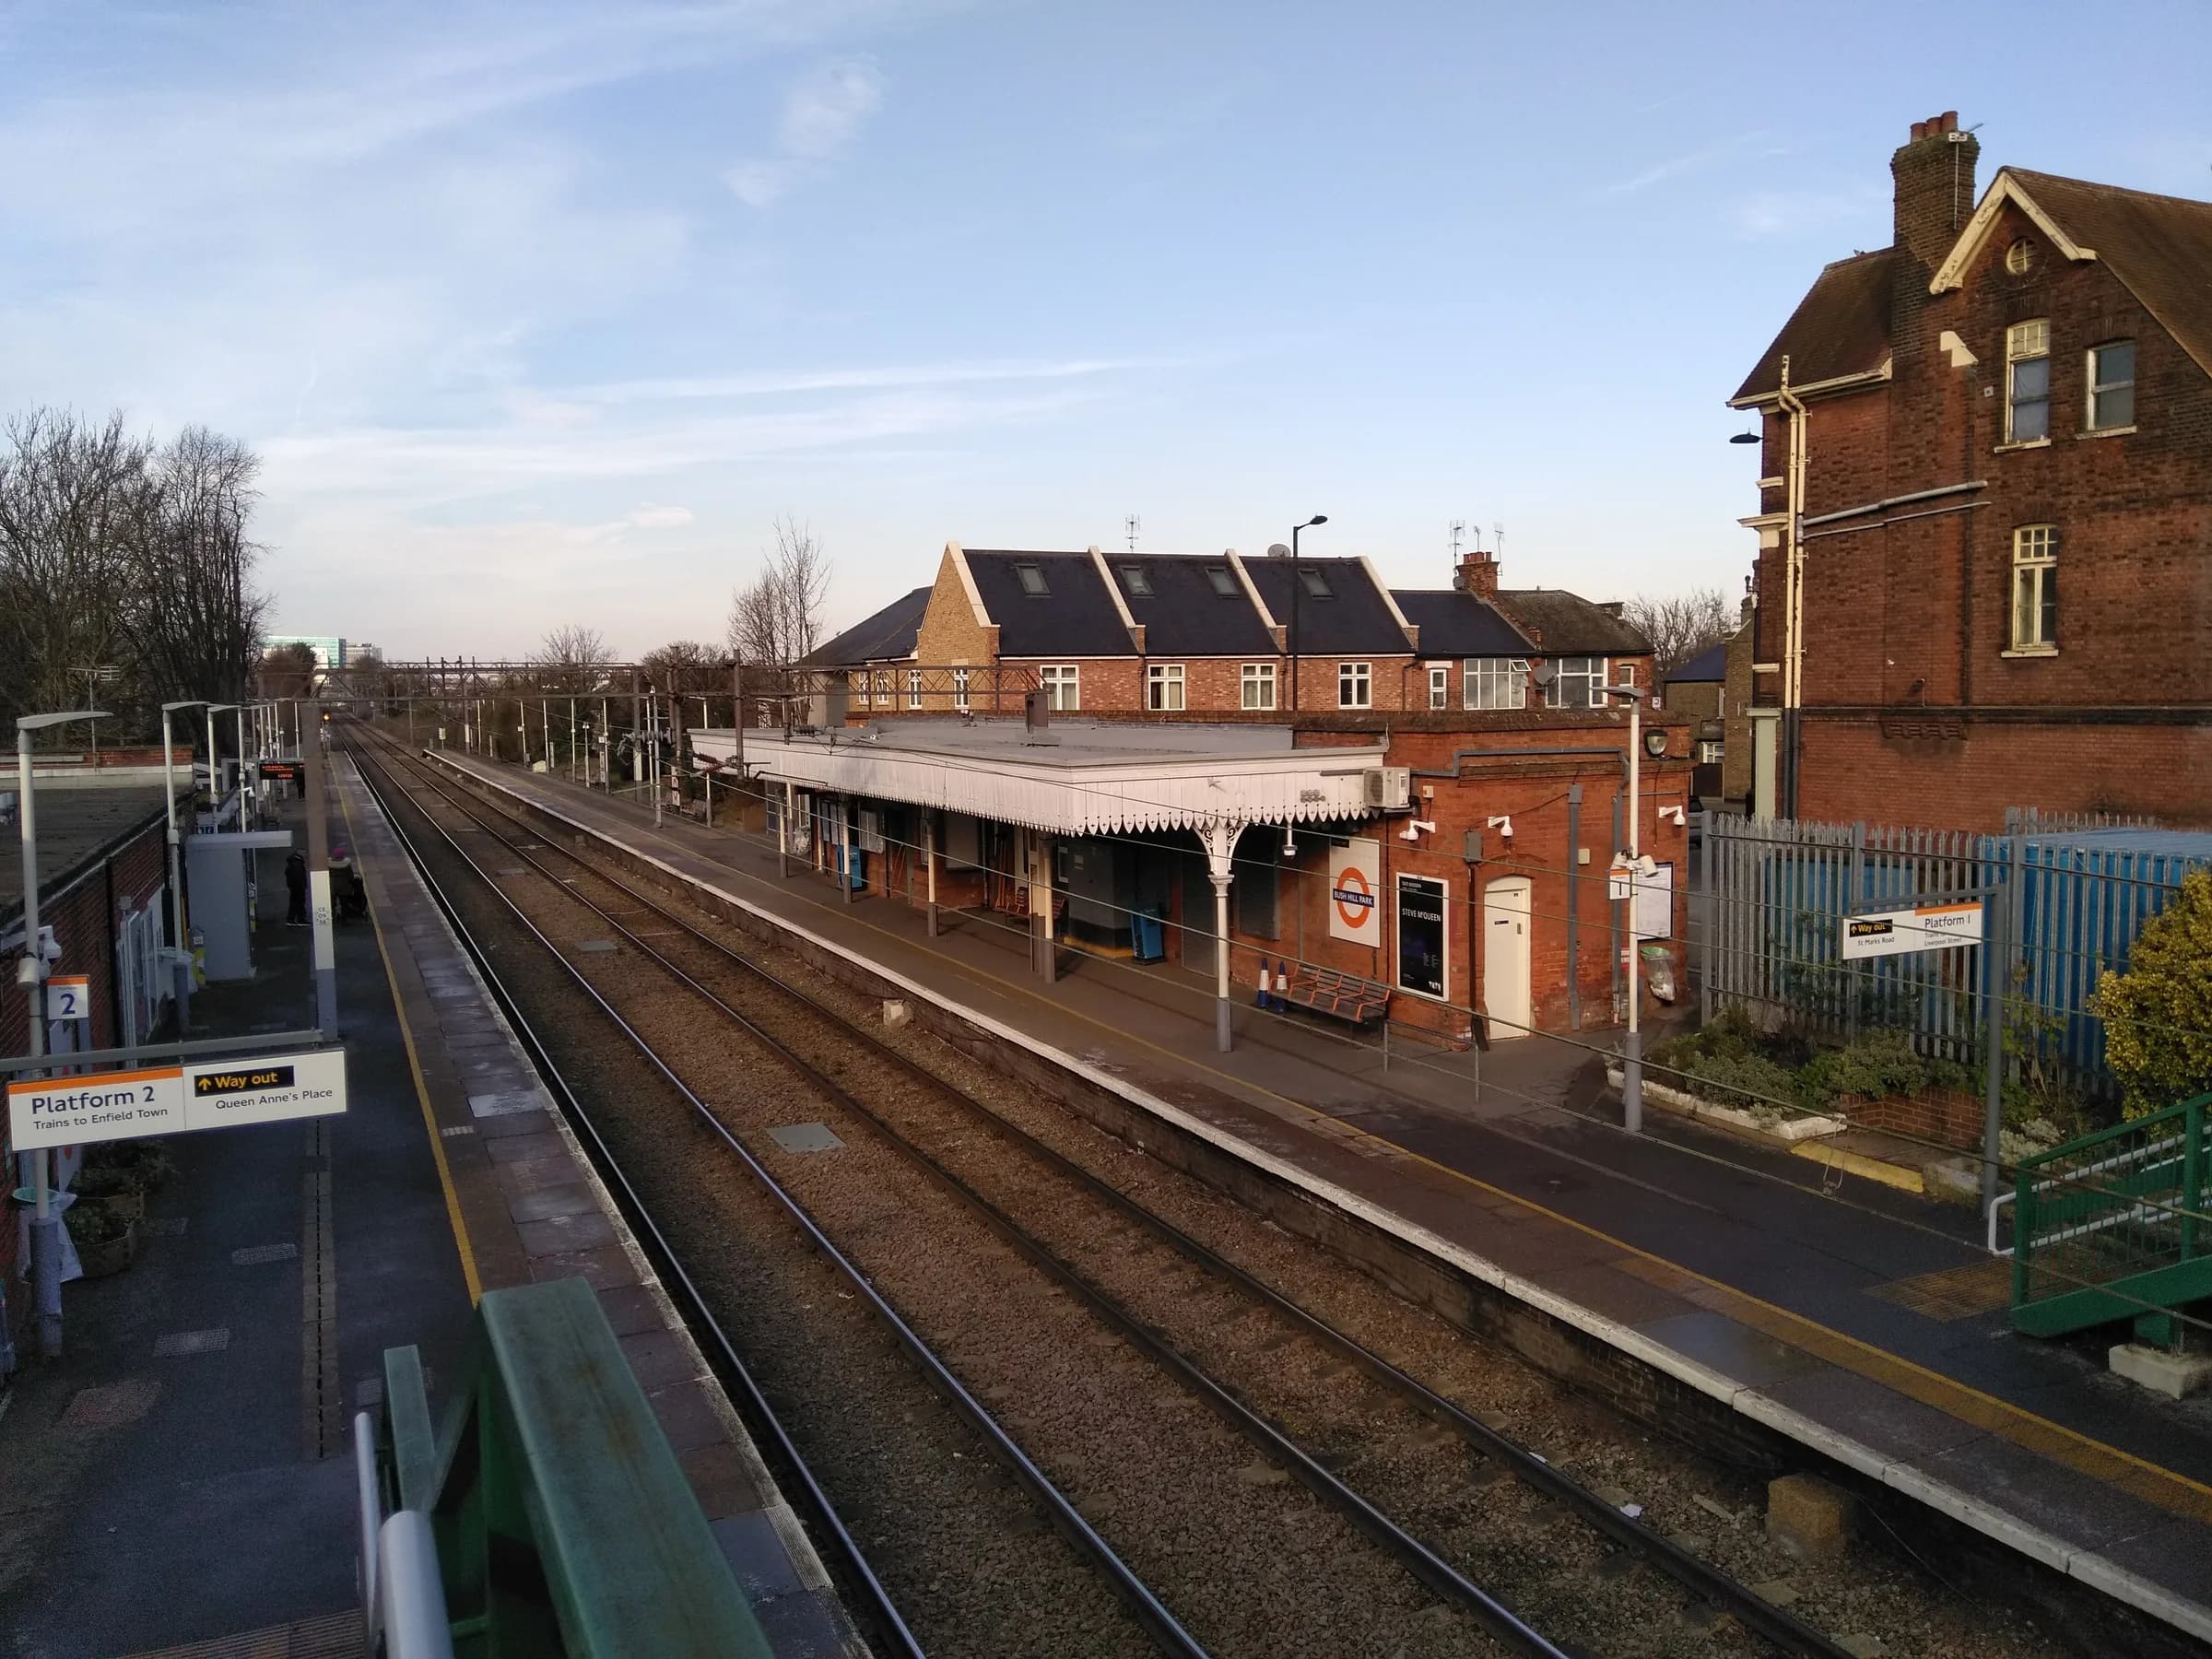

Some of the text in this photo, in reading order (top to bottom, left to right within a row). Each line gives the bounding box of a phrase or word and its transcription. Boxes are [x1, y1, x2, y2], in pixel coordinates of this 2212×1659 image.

[1334, 891, 1373, 905] BUSH HILL PARK
[1401, 908, 1418, 918] STEVE
[1857, 921, 1886, 933] Way out
[1924, 916, 1965, 928] Platform
[1865, 937, 1881, 946] Marks
[1881, 935, 1895, 944] Road
[1924, 937, 1947, 947] Liverpool
[60, 993, 76, 1015] 2
[215, 1072, 279, 1089] Way out
[31, 1086, 156, 1115] Platform 2
[216, 1088, 334, 1110] Queen Anne's Place
[33, 1107, 169, 1131] Trains to Enfield Town
